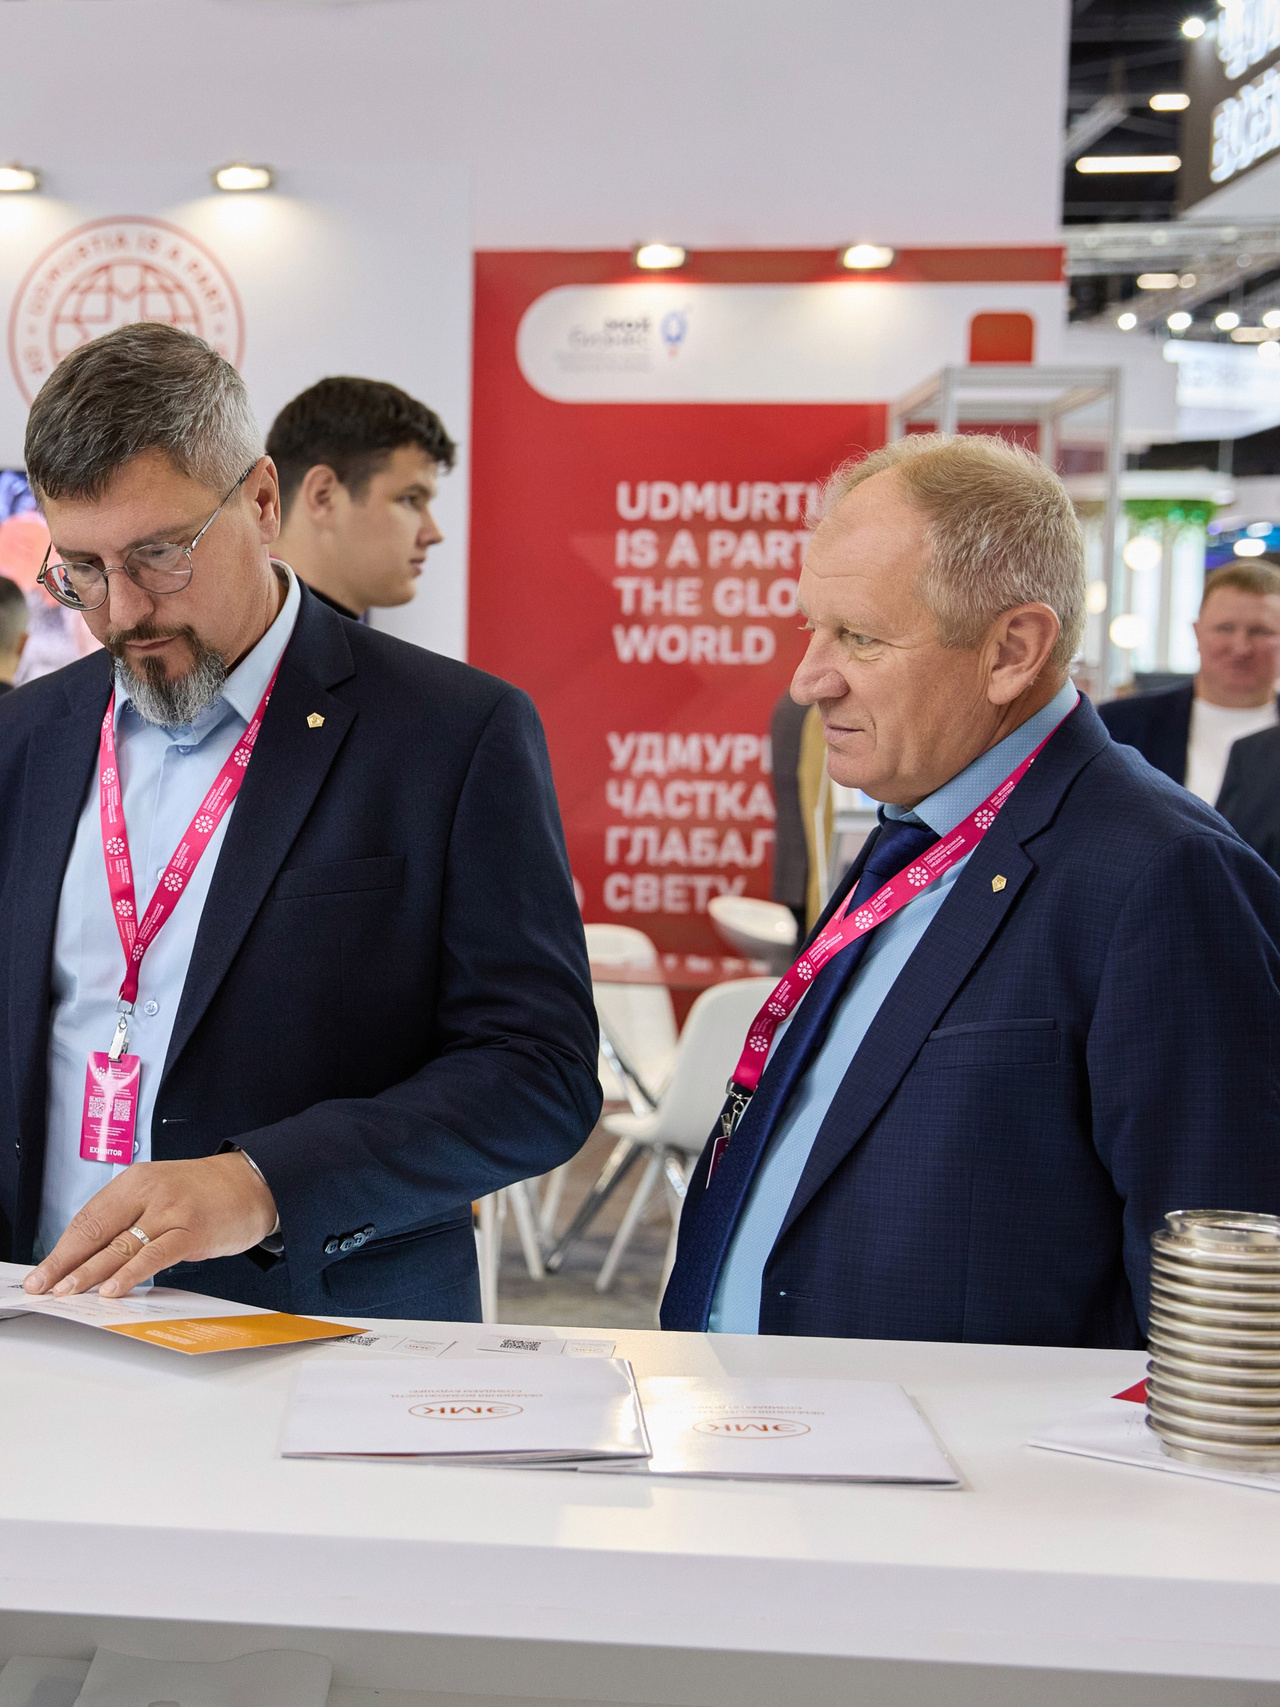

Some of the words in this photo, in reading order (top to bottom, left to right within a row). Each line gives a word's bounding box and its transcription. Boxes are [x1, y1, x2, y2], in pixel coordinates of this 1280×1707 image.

[615, 529, 658, 568] IS
[665, 529, 700, 569] A
[612, 577, 703, 616] THE
[713, 577, 803, 617] GLO
[612, 624, 776, 664] WORLD
[605, 779, 776, 820] ЧАСТКА
[423, 1406, 510, 1414] ЭМК
